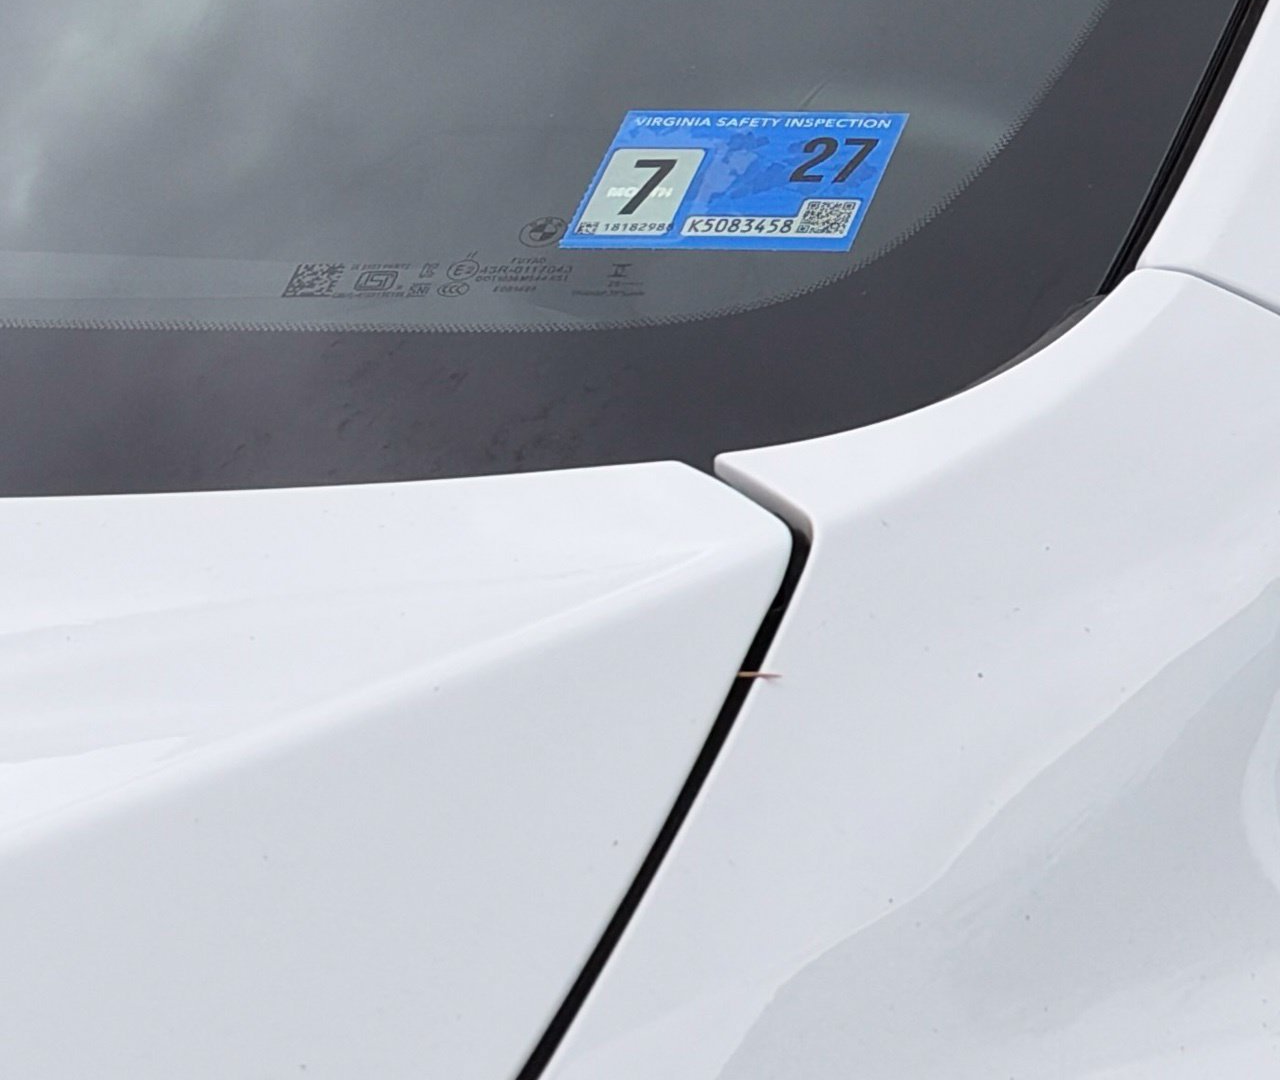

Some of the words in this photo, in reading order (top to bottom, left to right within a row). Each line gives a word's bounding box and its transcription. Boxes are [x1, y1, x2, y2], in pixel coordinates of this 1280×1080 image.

[636, 117, 711, 127] VIRGINIA
[716, 117, 781, 128] SAFETY
[784, 118, 892, 129] INSPECTION
[789, 137, 879, 184] 27
[617, 159, 678, 216] 7
[688, 219, 793, 234] K5083458
